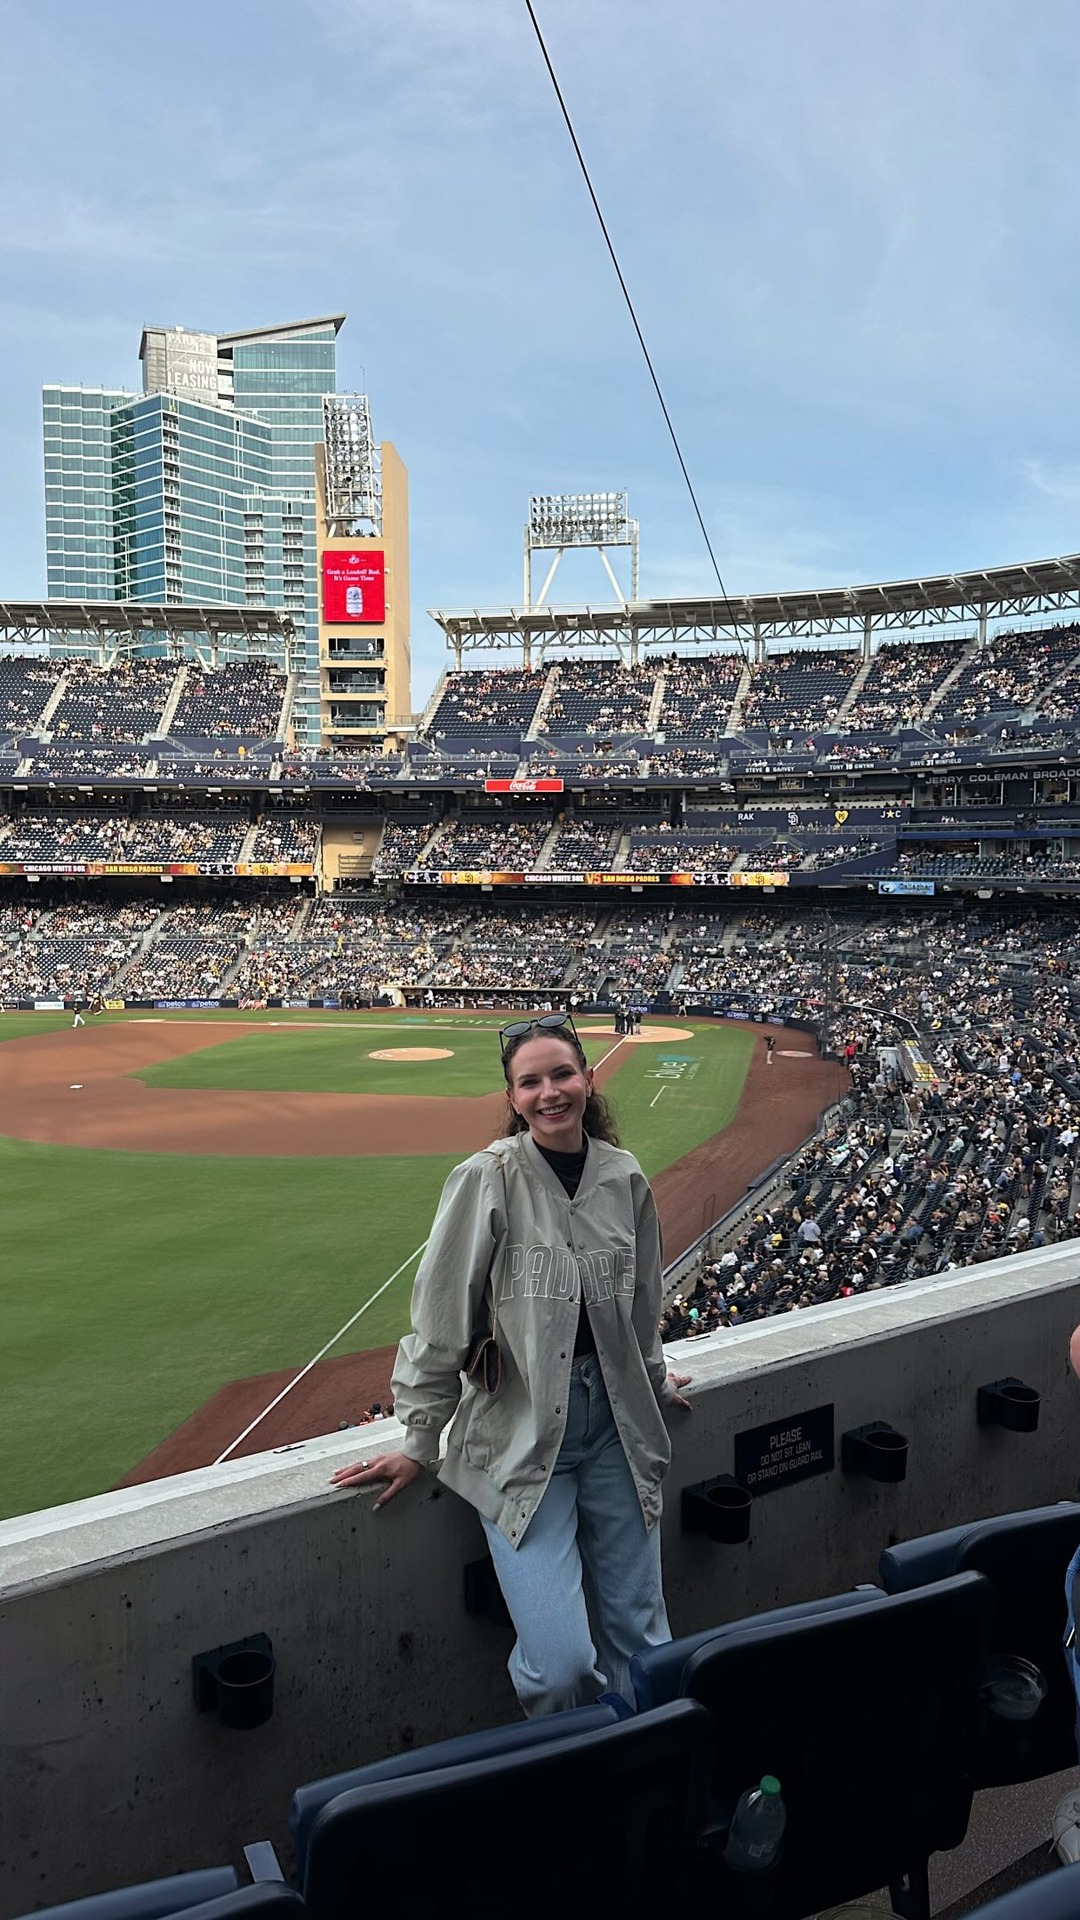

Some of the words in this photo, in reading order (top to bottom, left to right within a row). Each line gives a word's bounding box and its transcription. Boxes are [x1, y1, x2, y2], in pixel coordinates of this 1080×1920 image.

[190, 359, 216, 375] NOW
[167, 371, 217, 389] LEASING
[925, 775, 964, 785] JERRY
[969, 772, 1029, 783] COLEMAN
[738, 813, 755, 821] RAK
[118, 865, 138, 873] DIEGO
[138, 865, 164, 873] PADRES
[524, 874, 552, 882] CHICAGO
[552, 874, 572, 882] WHITE
[571, 874, 585, 882] SOX
[602, 875, 616, 883] SAN
[615, 875, 635, 883] DIEGO
[635, 875, 661, 883] PADRES
[166, 1000, 186, 1008] petco
[200, 1000, 220, 1008] petco
[643, 1062, 687, 1078] blue
[770, 1427, 802, 1449] PLEASE
[760, 1455, 770, 1467] DO
[770, 1449, 784, 1463] NOT
[796, 1440, 811, 1454] LEAN
[747, 1472, 757, 1484] OR
[757, 1465, 778, 1481] STAND
[778, 1461, 789, 1474] ON
[789, 1453, 810, 1470] GUARD
[811, 1449, 823, 1462] RAIL
